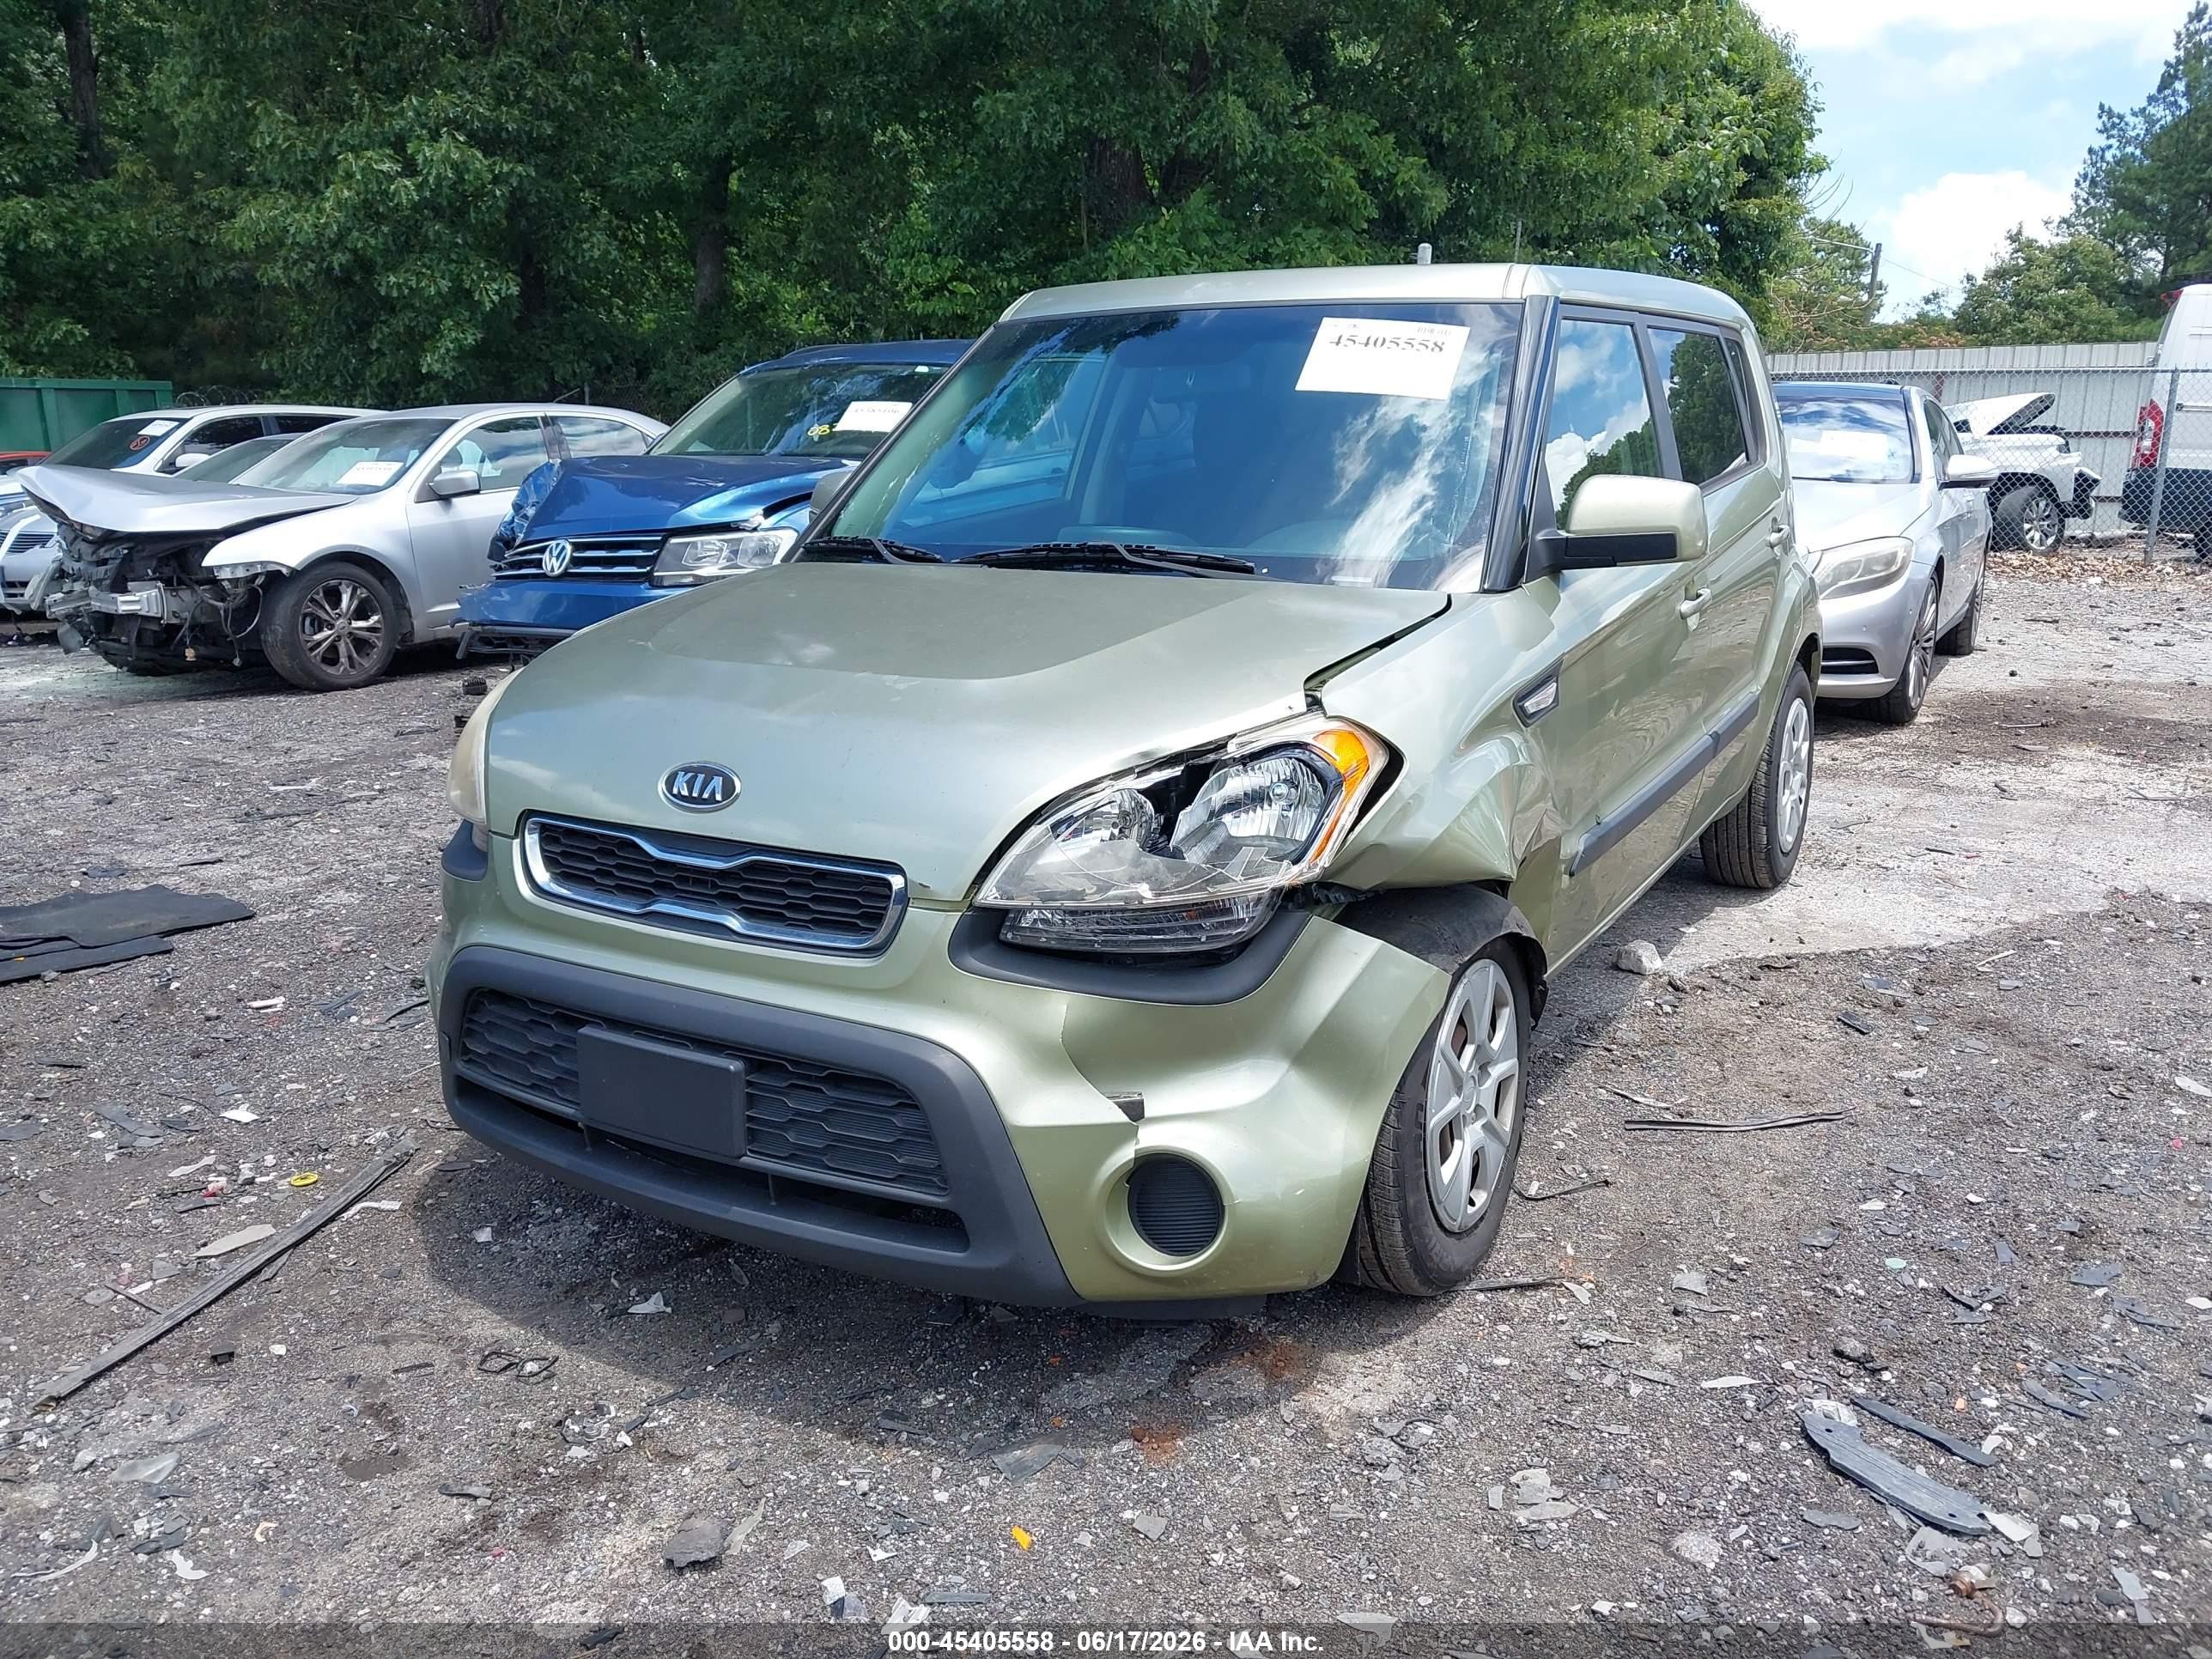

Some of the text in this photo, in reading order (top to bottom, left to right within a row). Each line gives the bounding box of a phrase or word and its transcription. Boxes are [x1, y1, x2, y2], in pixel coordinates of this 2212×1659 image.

[1328, 333, 1446, 353] 45405558
[543, 538, 571, 576] VW
[672, 770, 723, 802] KIA
